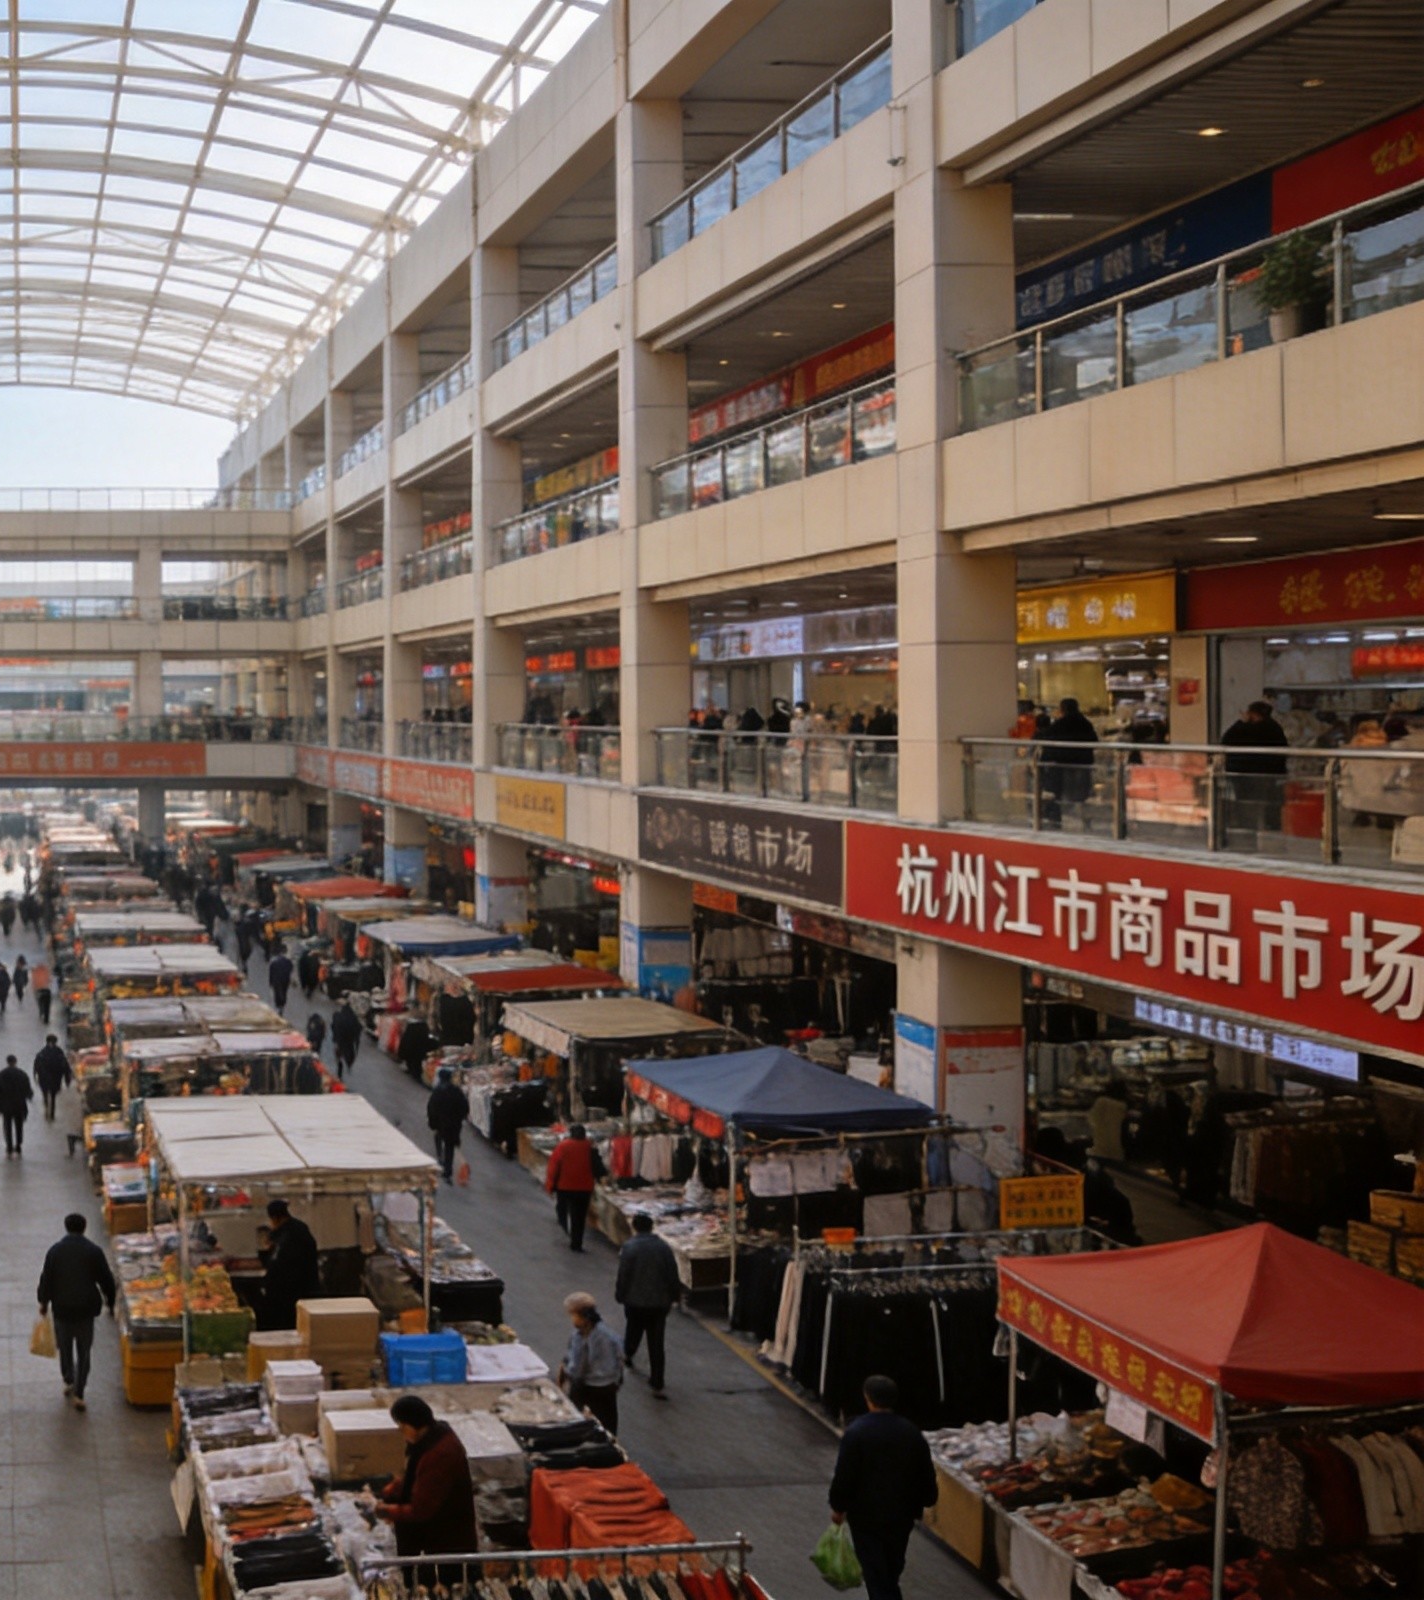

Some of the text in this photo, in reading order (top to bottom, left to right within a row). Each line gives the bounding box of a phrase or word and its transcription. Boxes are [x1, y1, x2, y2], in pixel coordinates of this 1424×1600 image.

[896, 843, 1424, 1021] 杭州江市商品市场
